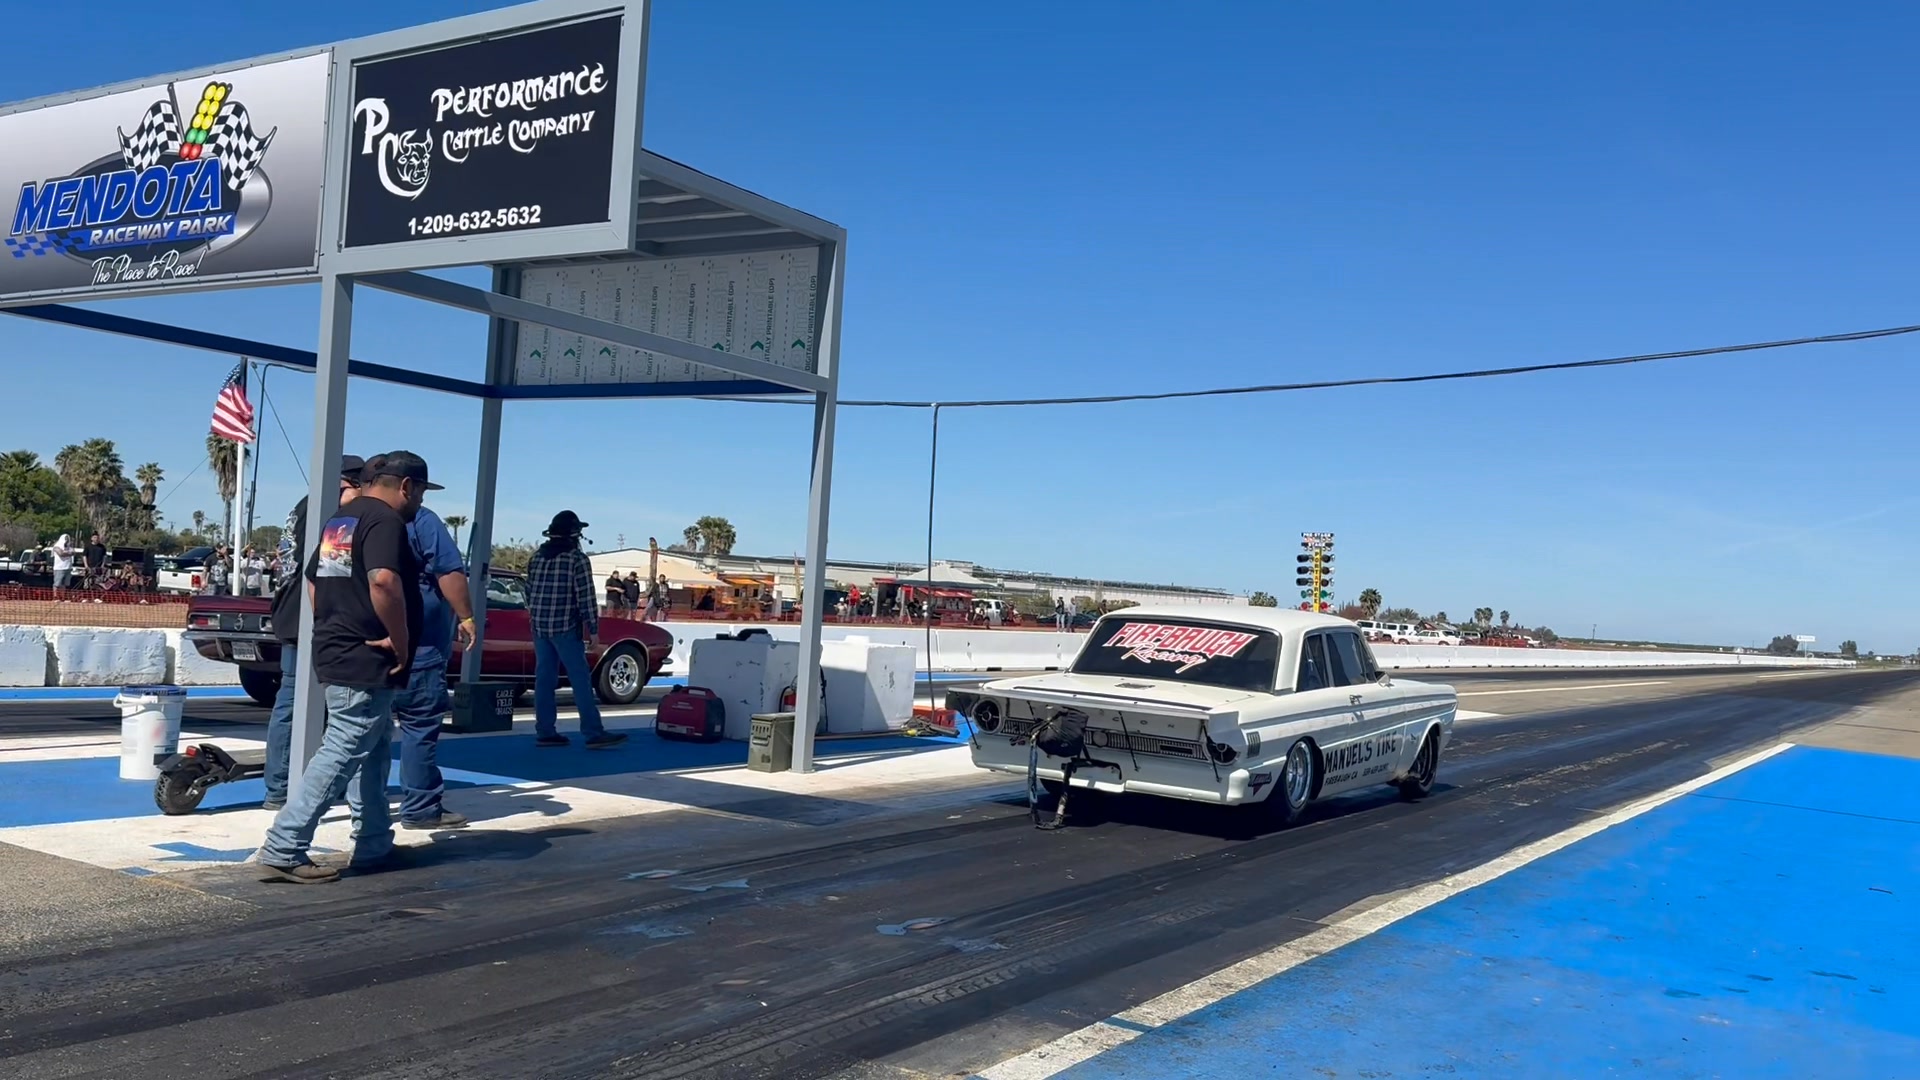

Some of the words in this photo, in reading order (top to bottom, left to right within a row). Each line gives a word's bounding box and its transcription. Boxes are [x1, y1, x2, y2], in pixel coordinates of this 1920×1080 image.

[431, 62, 608, 122] PERFORMANCE
[442, 122, 504, 164] CATTLE
[508, 111, 595, 153] COMPANY
[11, 156, 222, 236] MENDOTA
[89, 221, 172, 246] RACEWAY
[176, 215, 232, 237] PARK
[408, 205, 542, 235] 1-209-632-5632
[91, 257, 114, 286] The
[111, 254, 144, 283] Place
[146, 255, 165, 279] to
[160, 248, 207, 280] Race!
[725, 297, 734, 337] PRINTABLE
[766, 294, 774, 335] PRINTABLE
[807, 292, 816, 334] PRINTABLE
[804, 335, 813, 371] DIGITALLY
[1102, 622, 1259, 659] FIREBAUGH
[1121, 641, 1207, 674] Racing
[495, 689, 514, 698] EAGLE
[496, 698, 513, 707] FIELD
[1324, 739, 1373, 774] MANUEL'S
[1376, 731, 1397, 757] TIRE
